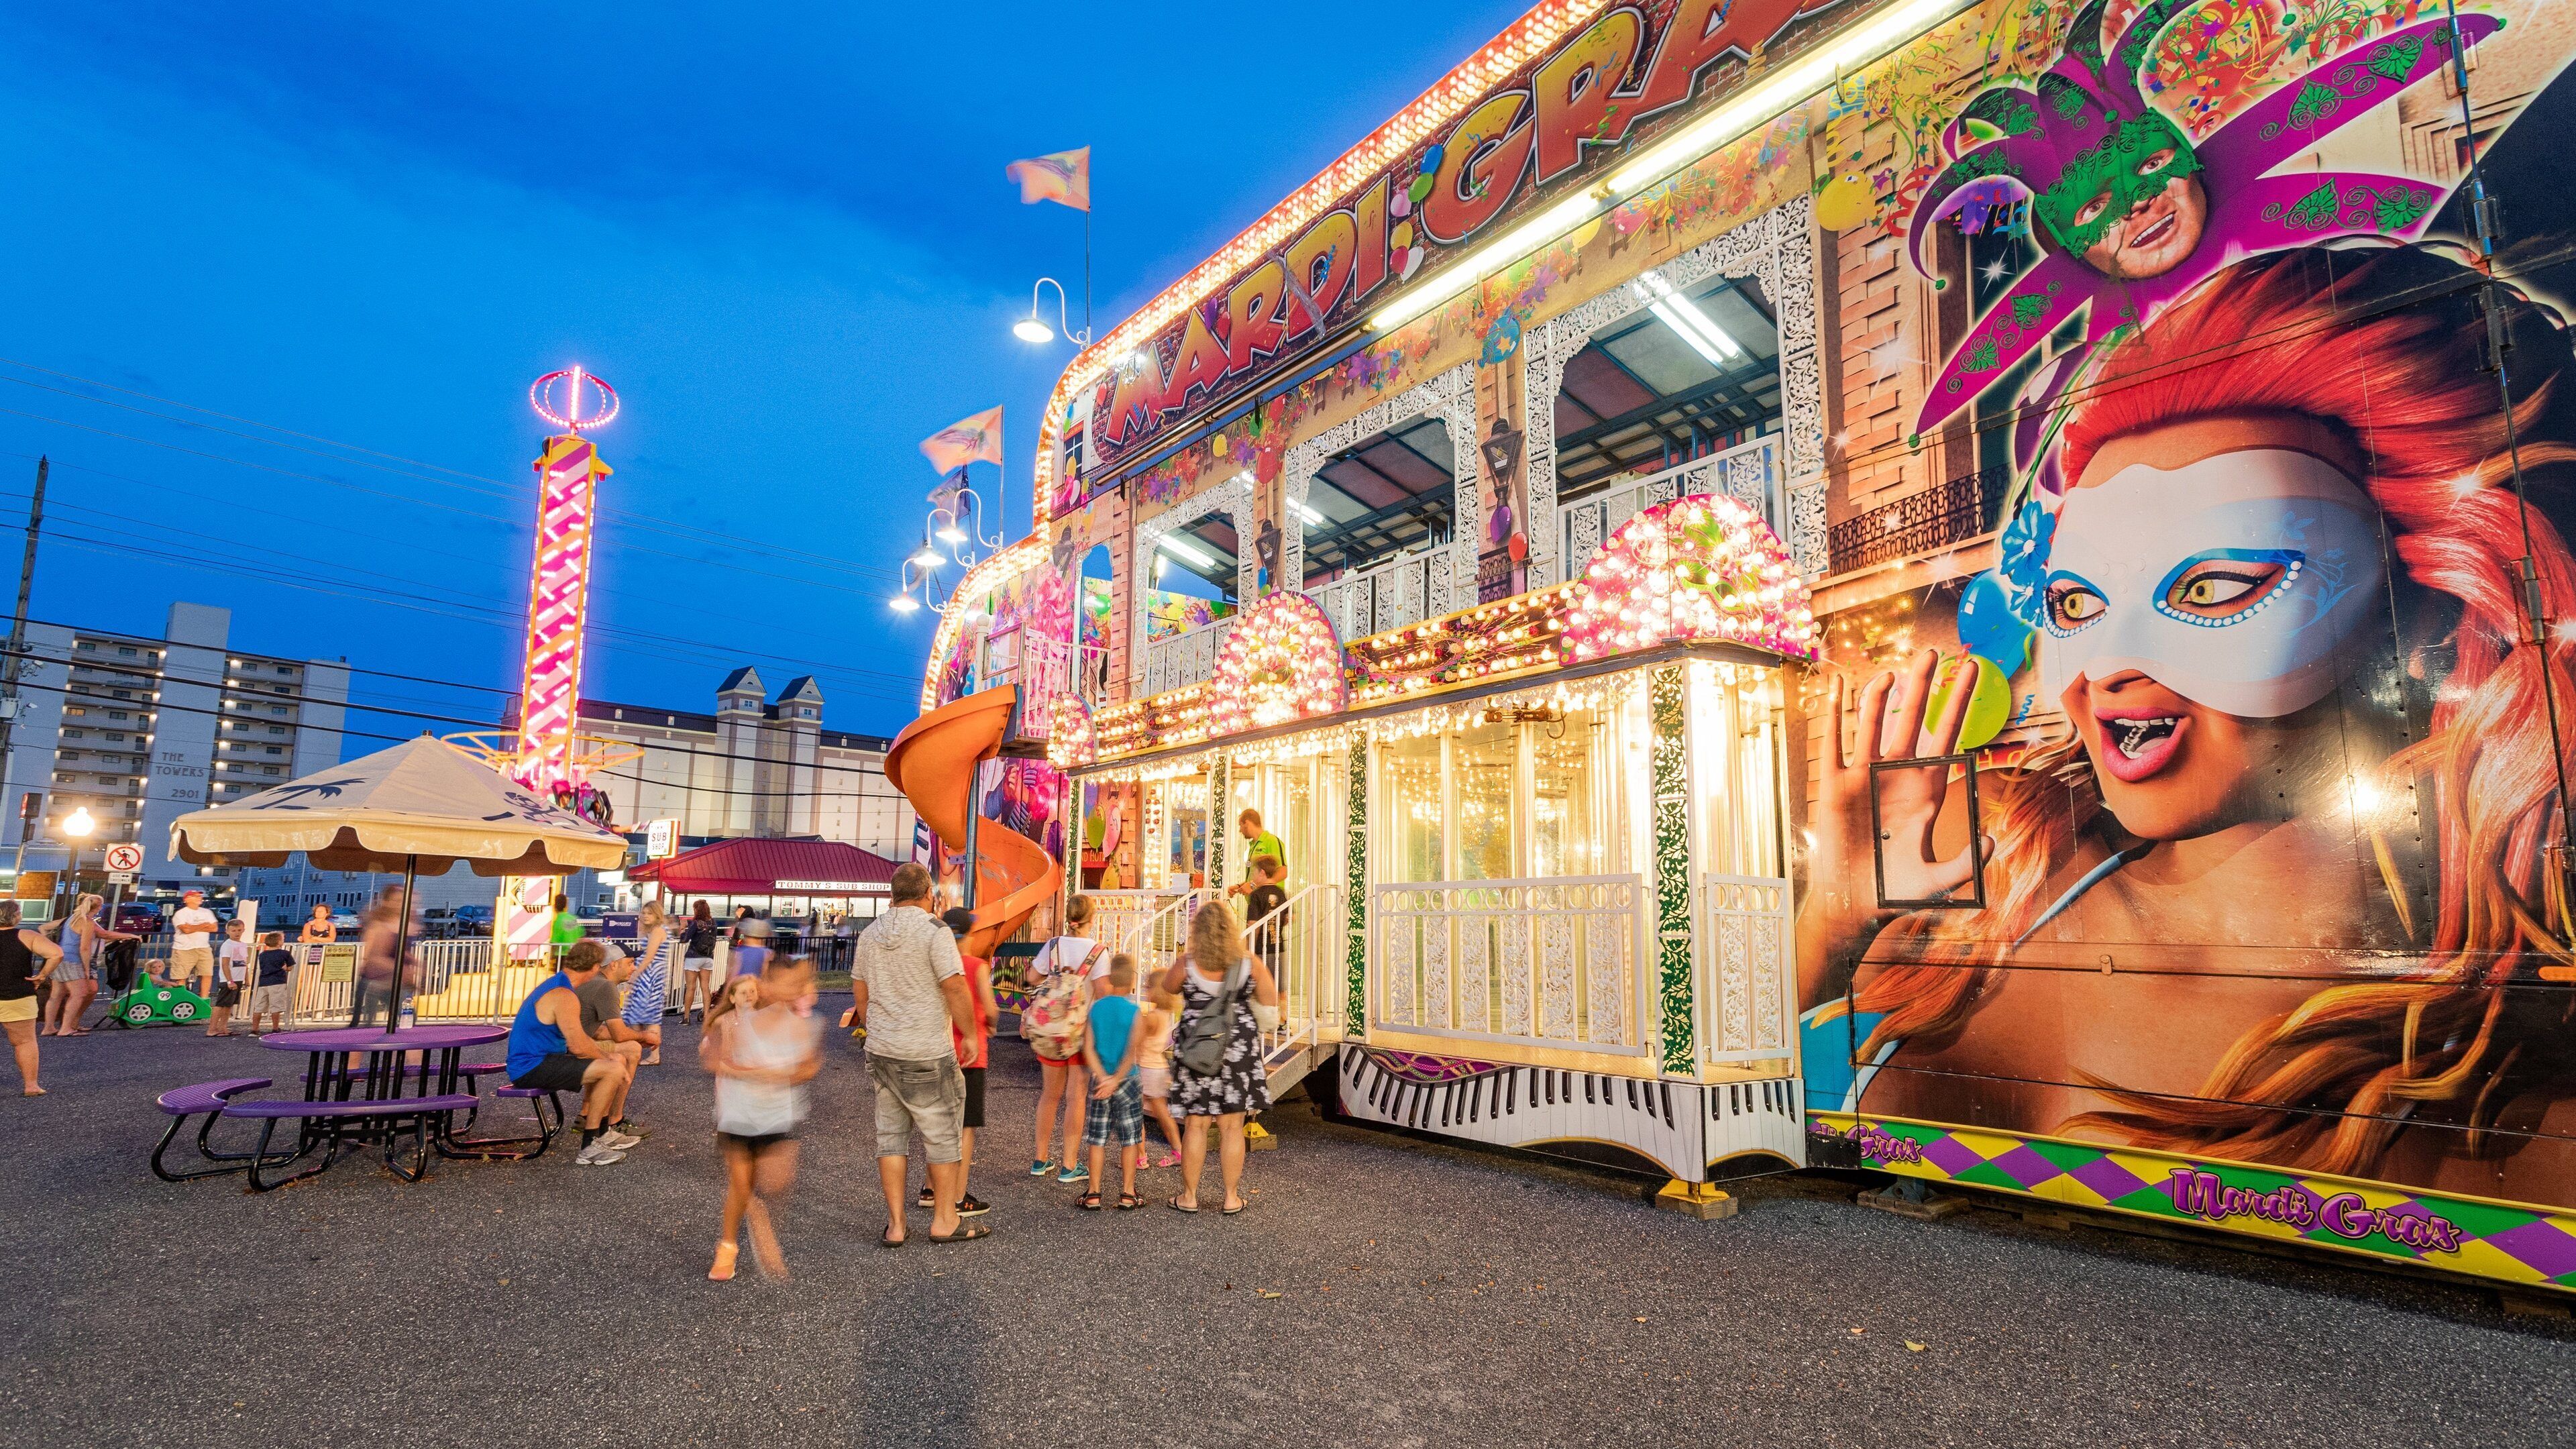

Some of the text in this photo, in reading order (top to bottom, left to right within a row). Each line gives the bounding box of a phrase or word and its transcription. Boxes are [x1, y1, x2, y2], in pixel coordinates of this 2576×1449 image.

[1104, 0, 1846, 445] MARDI GRA
[162, 752, 184, 762] THE
[156, 765, 204, 777] TOWERS
[171, 789, 199, 799] 2901
[651, 832, 667, 842] SUB
[778, 881, 832, 889] TOMMY'S
[2169, 1168, 2462, 1253] Mardi Gras
